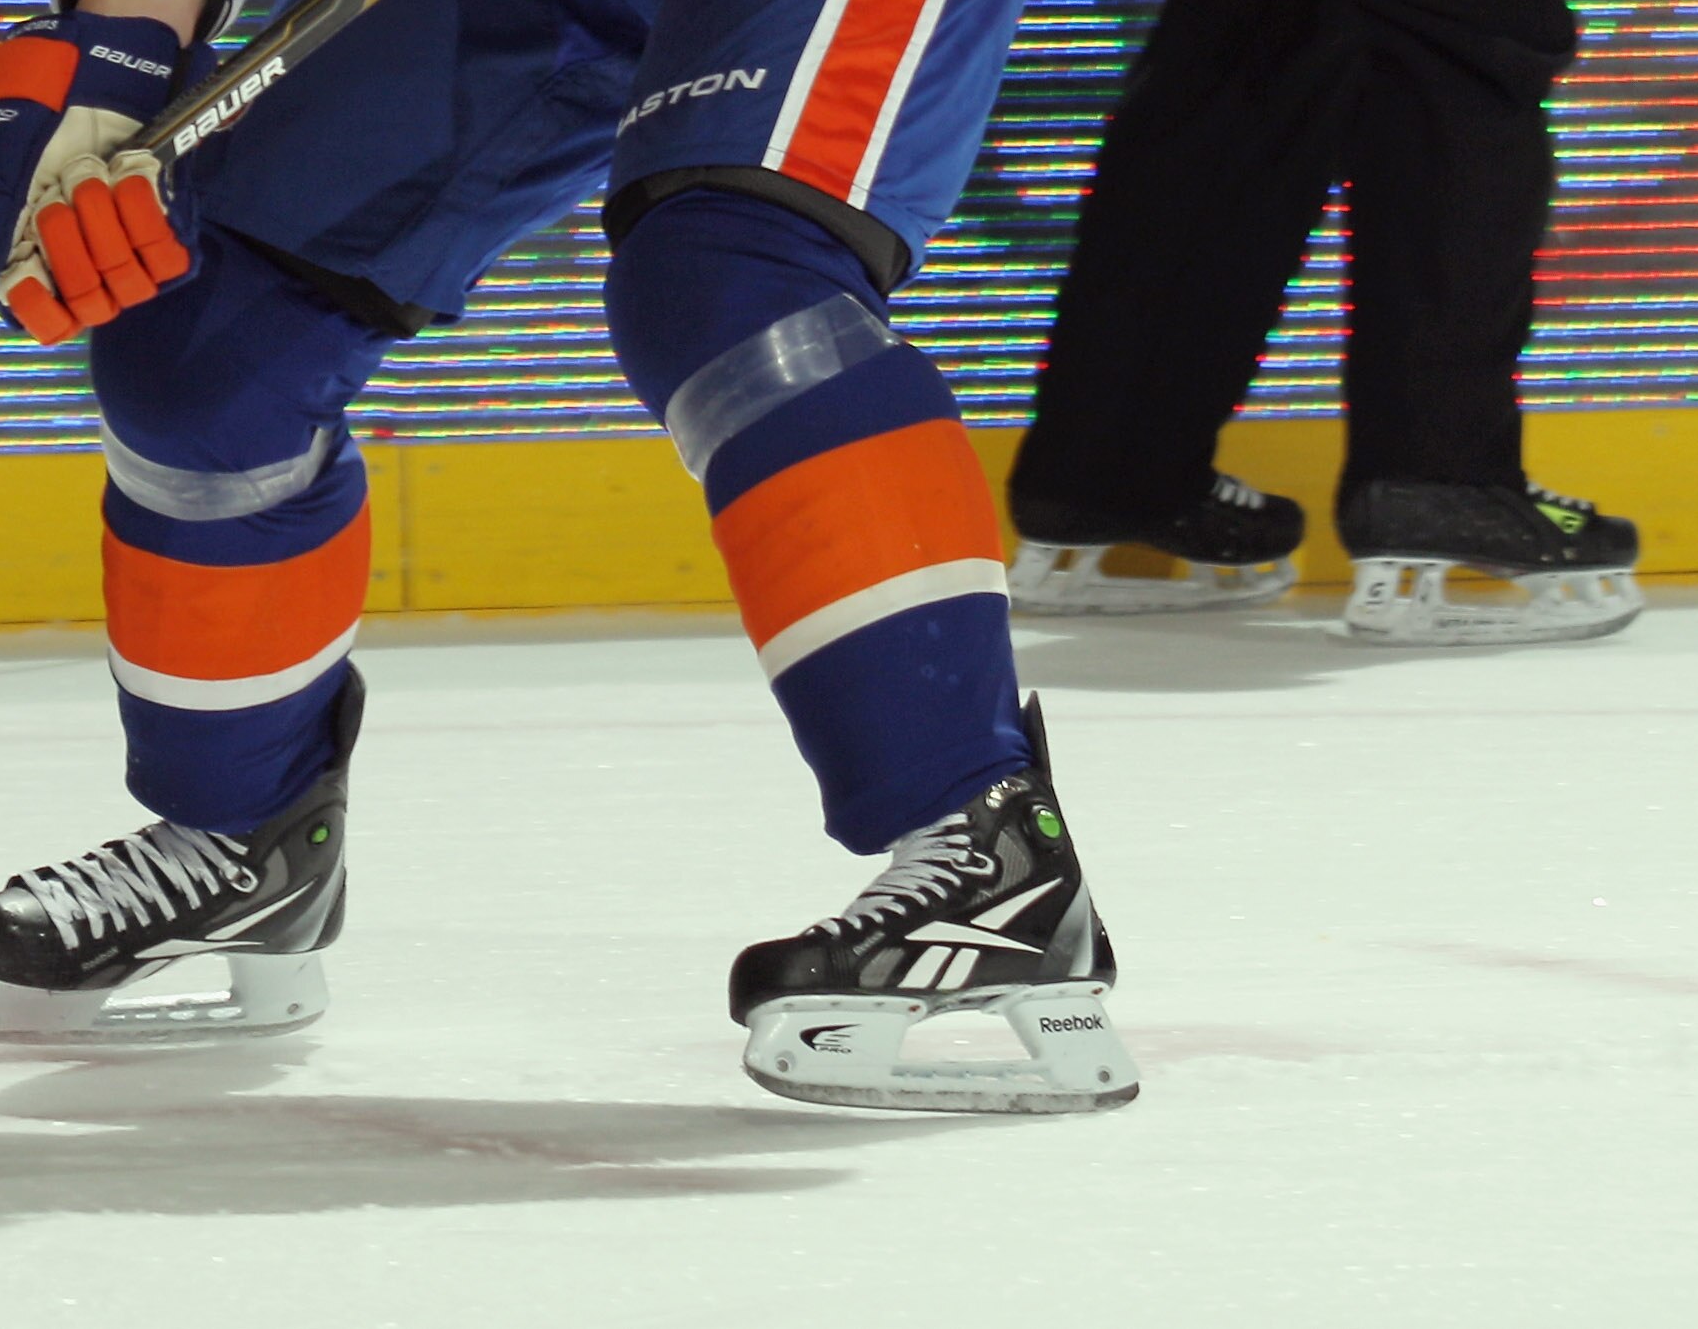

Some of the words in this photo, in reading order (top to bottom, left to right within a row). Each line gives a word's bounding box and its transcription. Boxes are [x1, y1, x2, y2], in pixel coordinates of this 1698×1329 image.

[89, 44, 173, 79] BAUER
[173, 56, 287, 156] BAUER
[1039, 1013, 1105, 1034] Reebok
